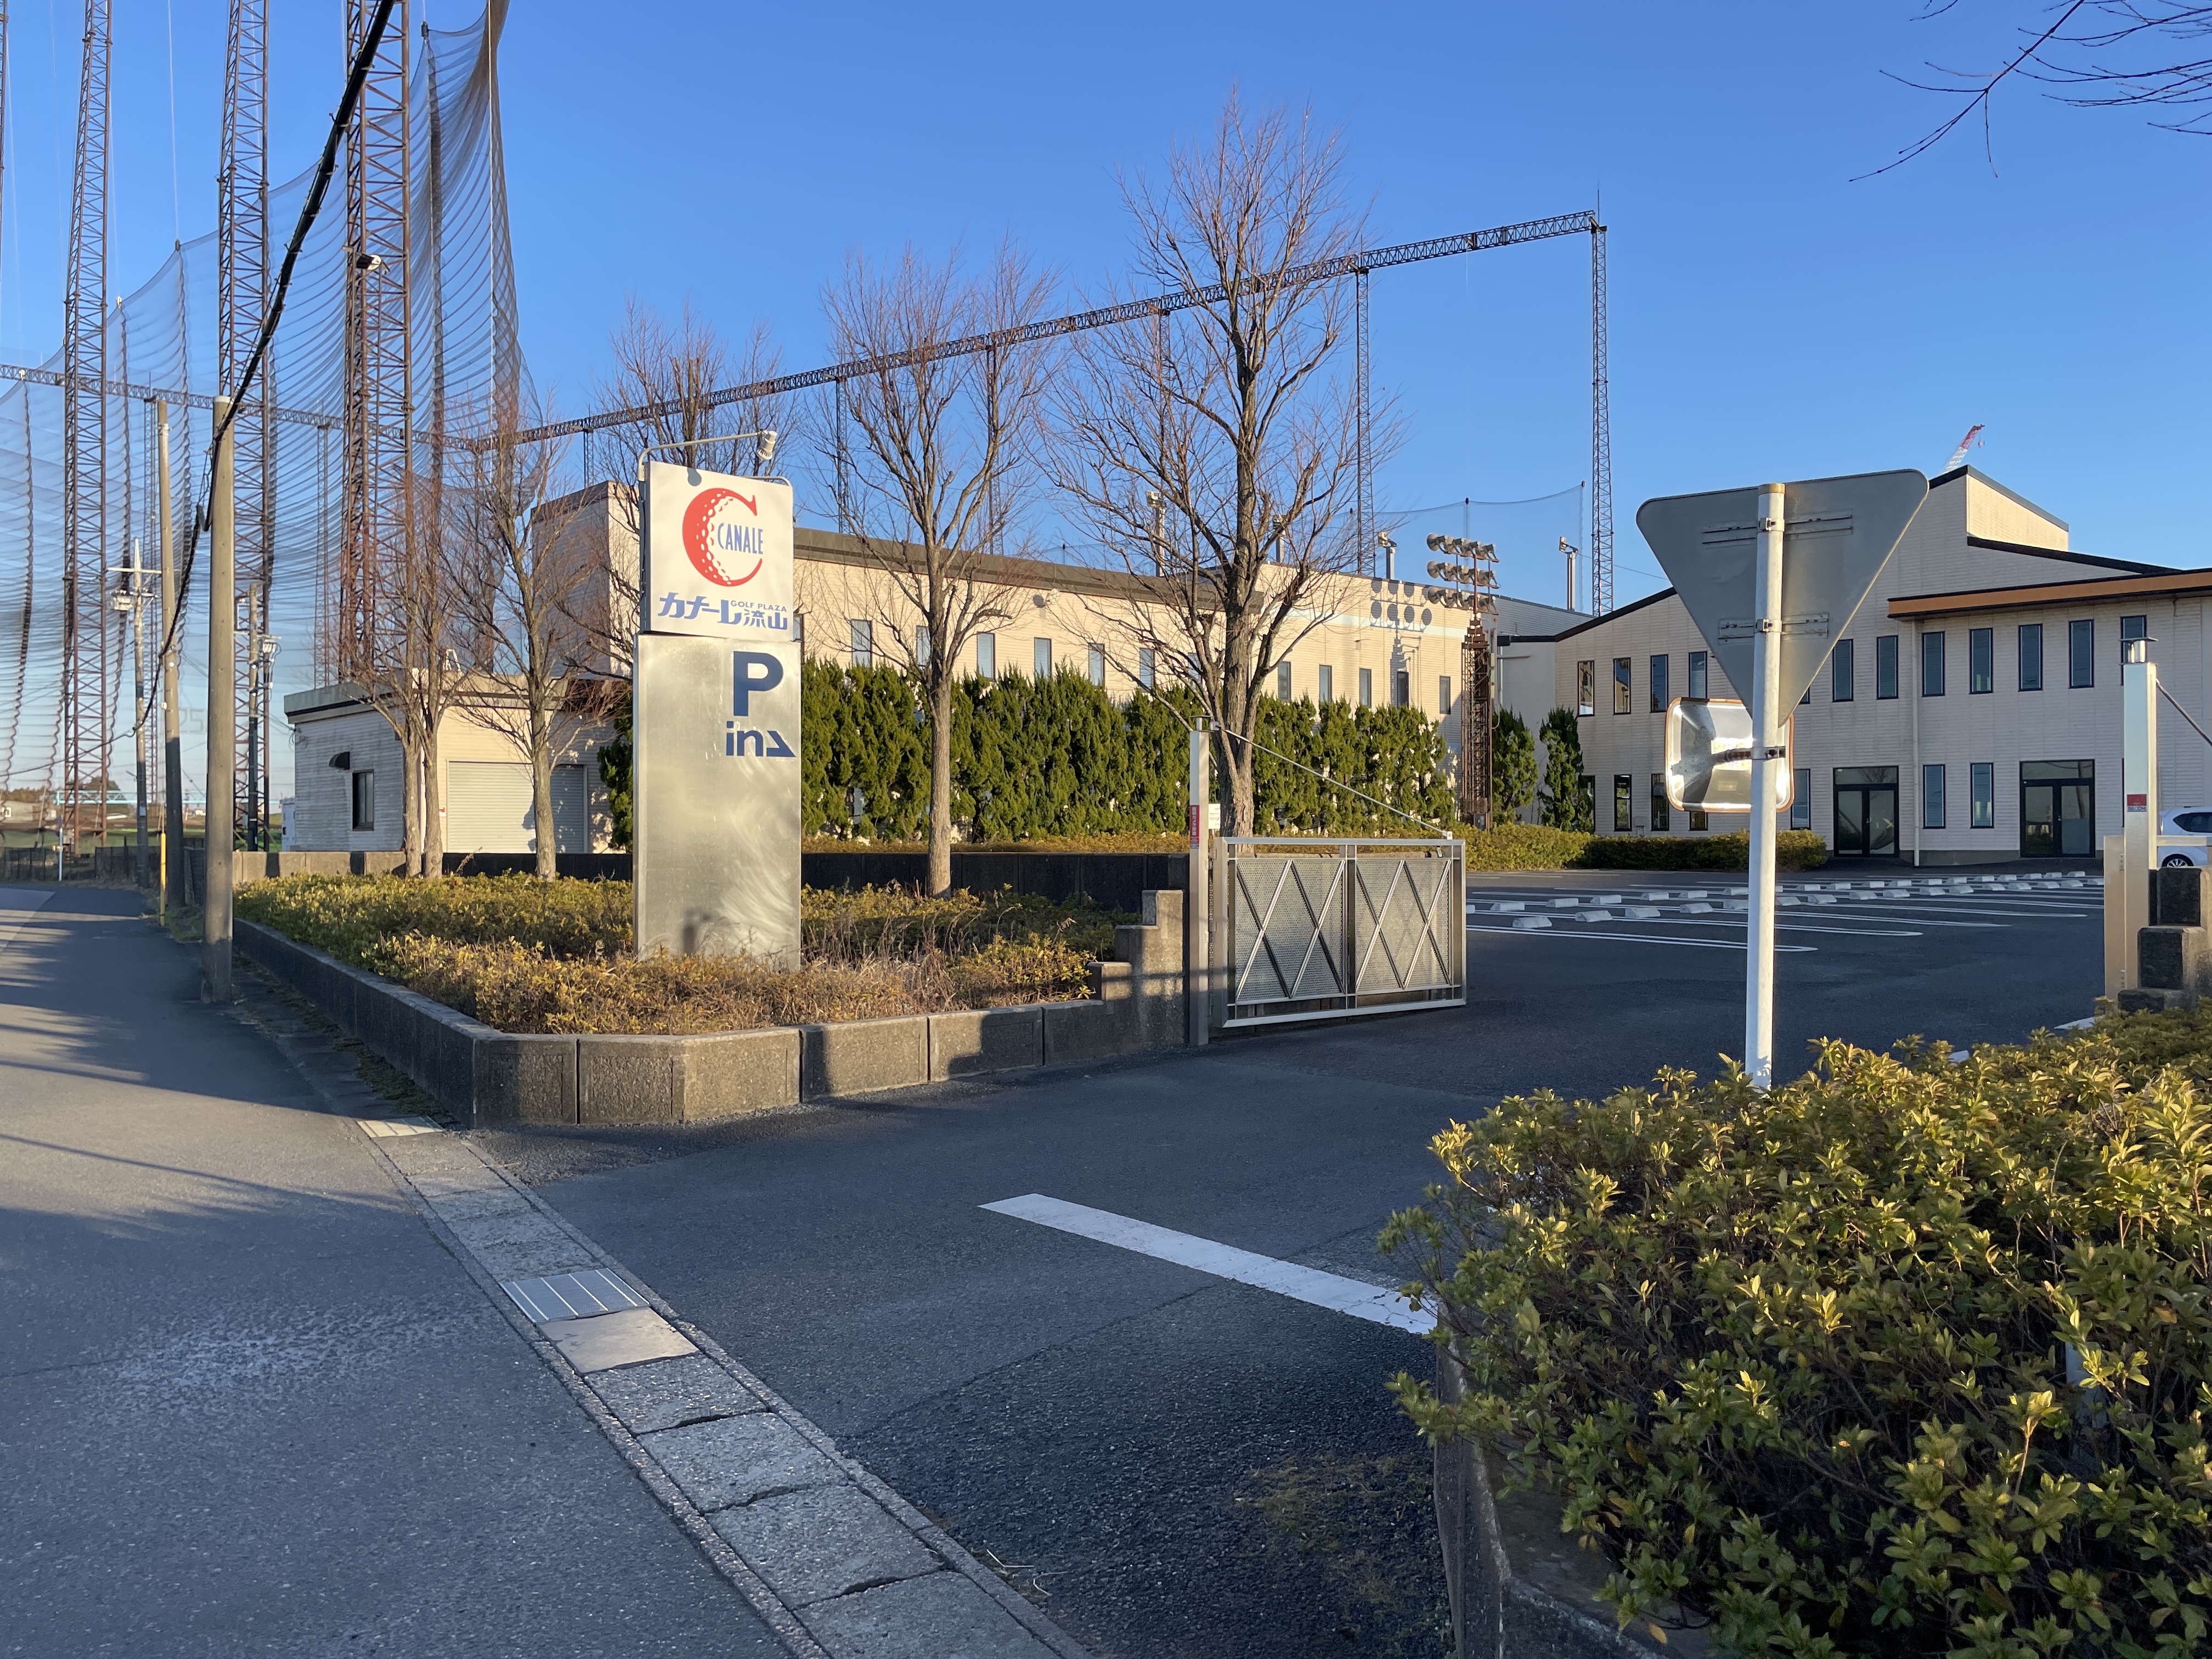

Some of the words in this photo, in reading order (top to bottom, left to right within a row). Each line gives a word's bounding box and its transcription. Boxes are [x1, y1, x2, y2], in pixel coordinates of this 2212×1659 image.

[717, 522, 763, 555] CANALE
[658, 591, 787, 630] カナーレ流山
[731, 600, 754, 609] GOLF
[758, 603, 787, 612] PLAZA
[733, 651, 784, 716] P
[726, 720, 764, 757] in
